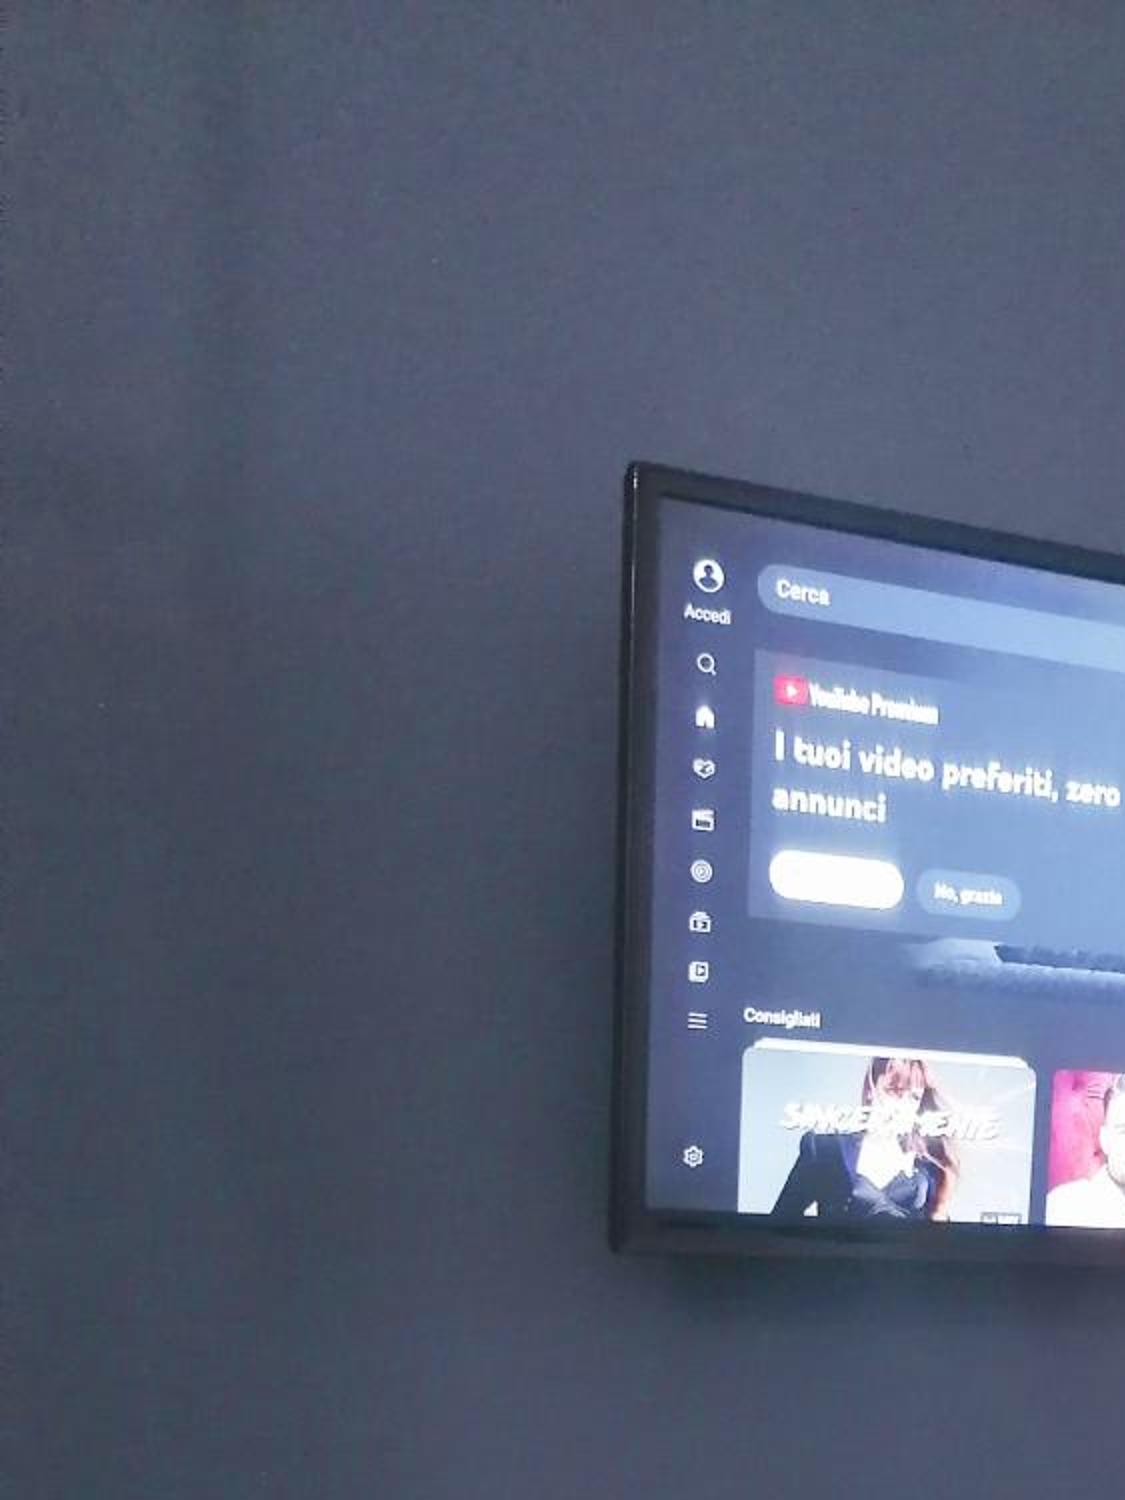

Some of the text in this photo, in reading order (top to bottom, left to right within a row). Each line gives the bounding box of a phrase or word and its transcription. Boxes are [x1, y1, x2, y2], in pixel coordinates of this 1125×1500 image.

[776, 579, 831, 606] Cerca
[684, 603, 732, 626] Accedi
[774, 730, 1121, 807] I tuoi video preferiti, zero
[772, 787, 886, 823] annunci
[743, 1006, 821, 1029] Consigliati
